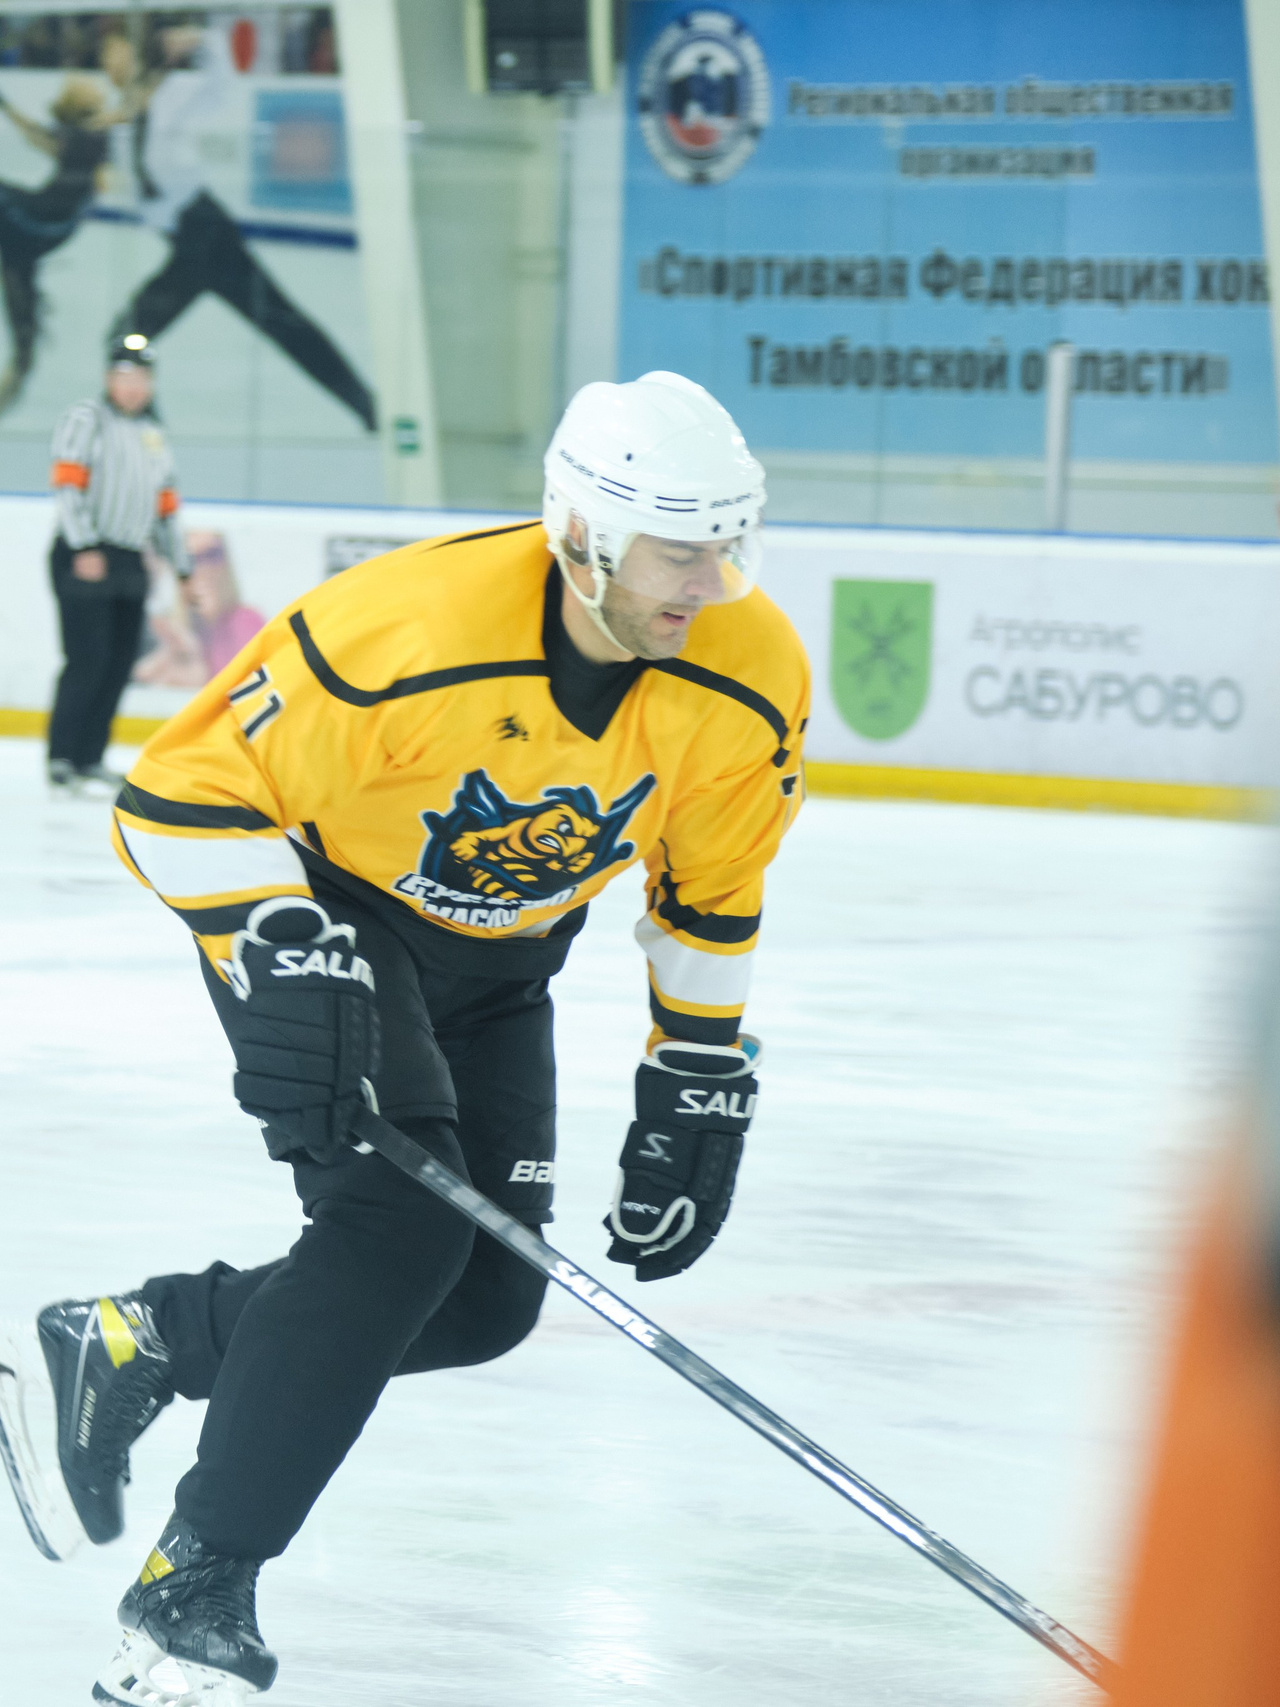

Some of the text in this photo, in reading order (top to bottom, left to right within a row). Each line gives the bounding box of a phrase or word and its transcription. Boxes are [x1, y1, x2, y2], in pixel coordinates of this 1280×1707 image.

[920, 249, 1184, 308] Федерация
[746, 335, 1231, 396] Тамбовской оласти»
[965, 663, 1246, 734] САБУРОВО
